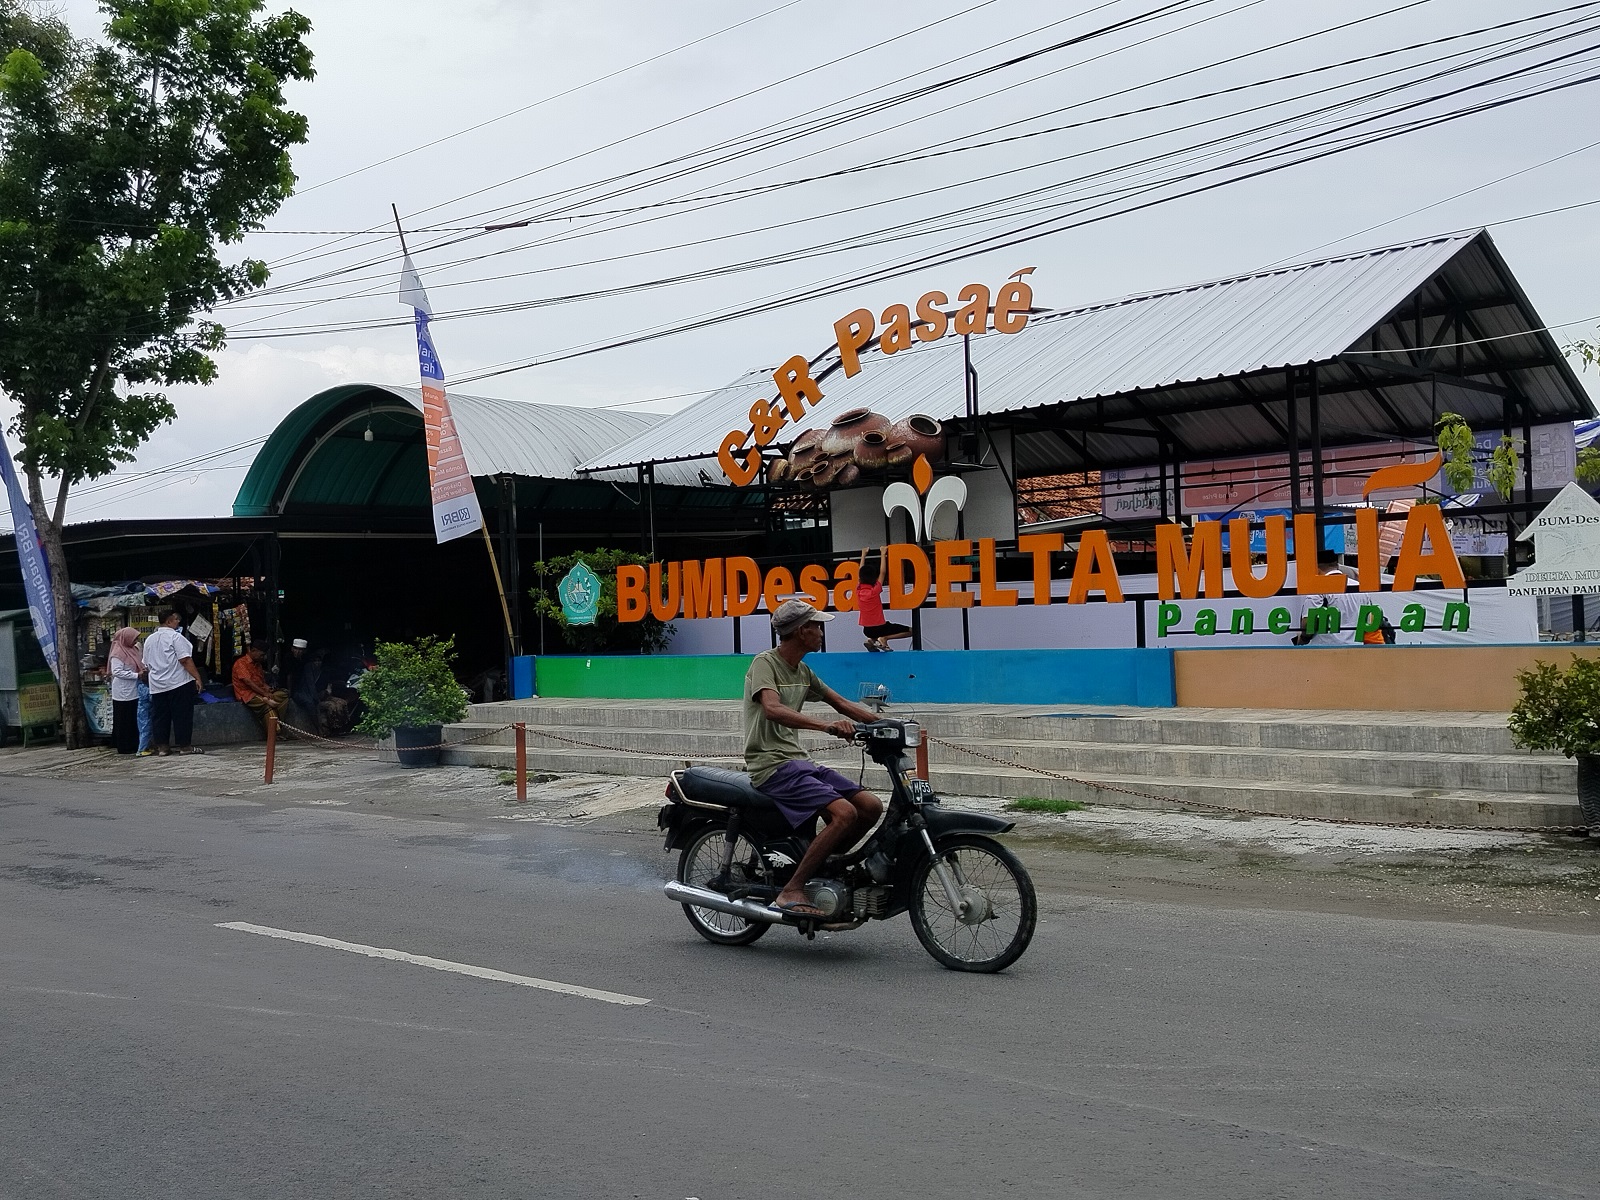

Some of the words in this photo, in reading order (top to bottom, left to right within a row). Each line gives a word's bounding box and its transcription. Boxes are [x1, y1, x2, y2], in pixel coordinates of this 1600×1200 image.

[616, 555, 860, 624] BUMDesa
[888, 531, 1124, 612] DELTA
[1525, 571, 1573, 583] DELTA
[1508, 585, 1569, 597] PANEMPAN
[1158, 599, 1471, 642] Panempan
